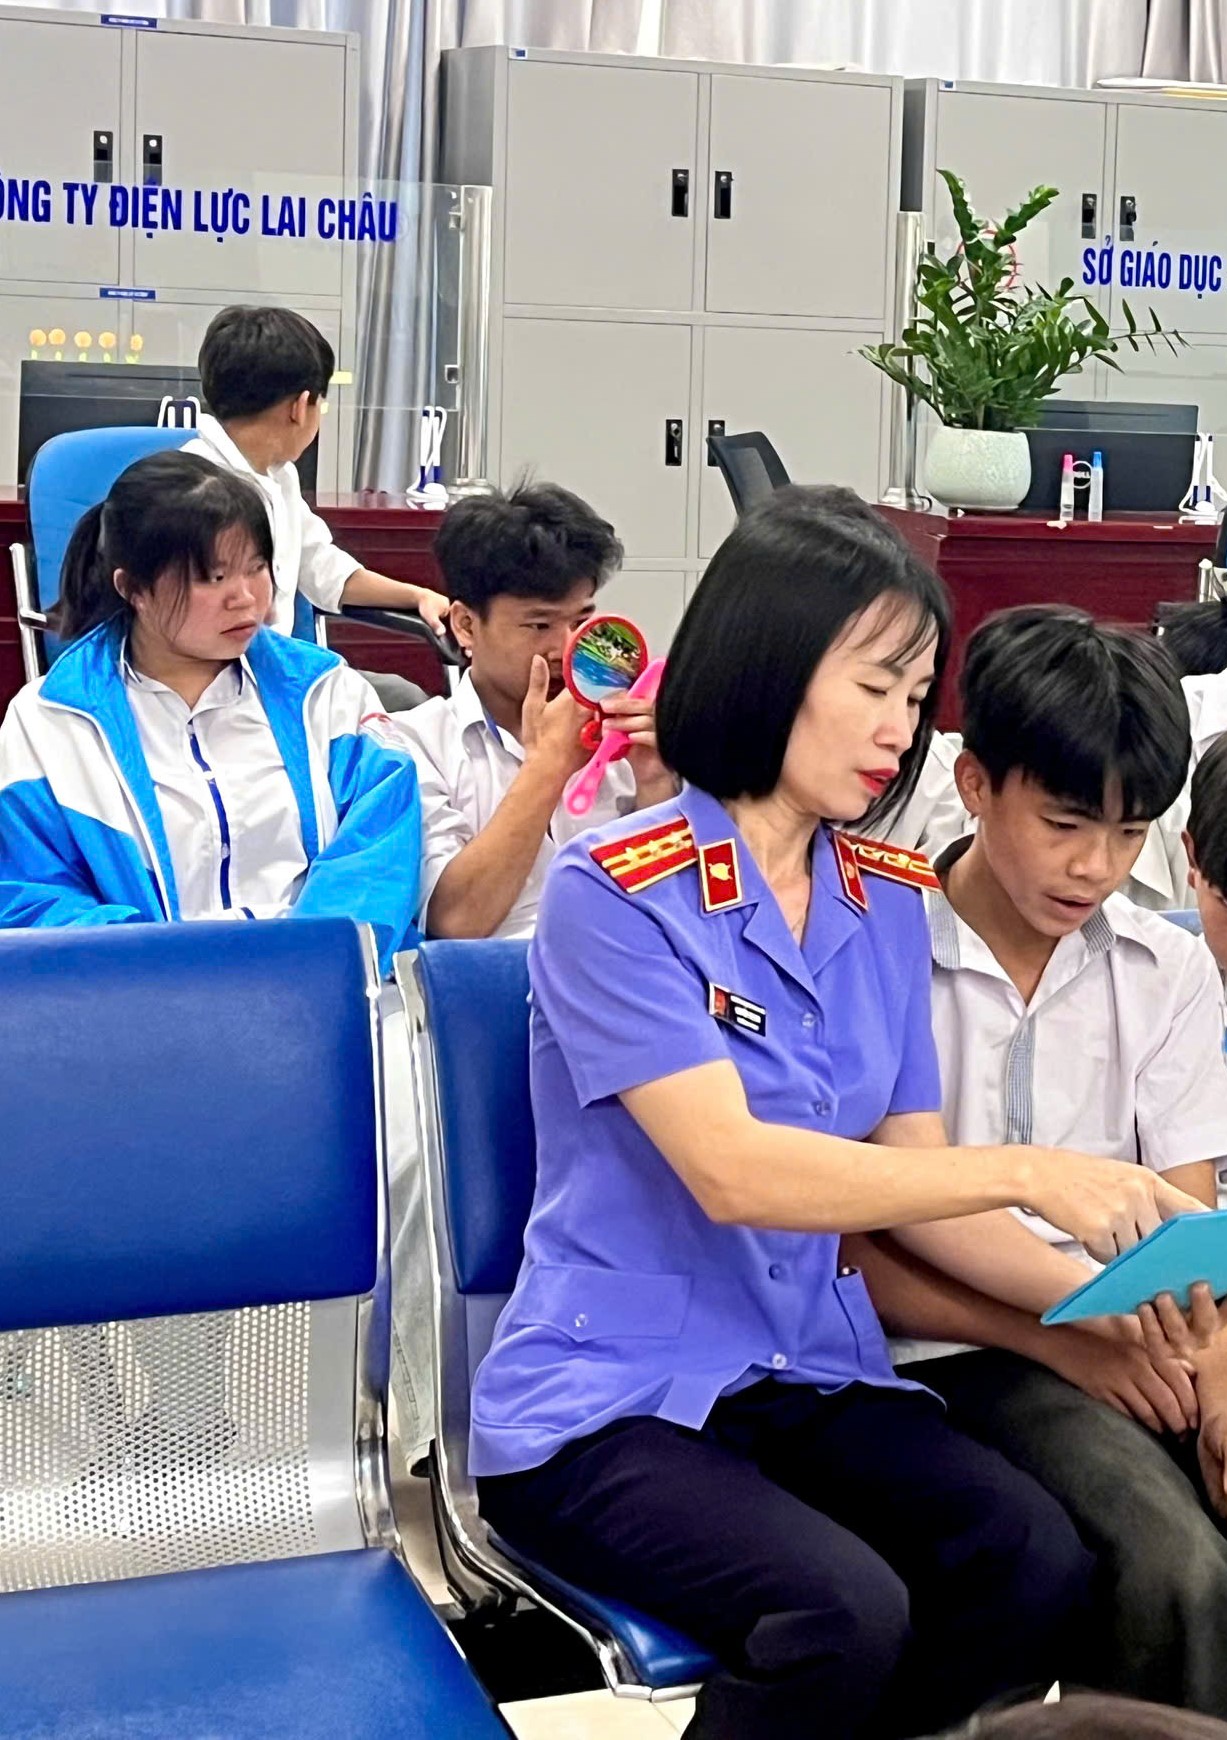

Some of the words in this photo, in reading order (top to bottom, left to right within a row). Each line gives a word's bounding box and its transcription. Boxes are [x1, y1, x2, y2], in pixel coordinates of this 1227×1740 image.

[0, 172, 51, 223] NG
[63, 182, 98, 225] TY
[109, 176, 182, 239] ĐIỆN
[194, 188, 249, 243] LỰC
[262, 195, 306, 237] LAI
[318, 192, 397, 242] CHÂU
[1083, 235, 1113, 286] SỞ
[1120, 240, 1172, 290] GIÁO
[1179, 253, 1222, 299] DỤC
